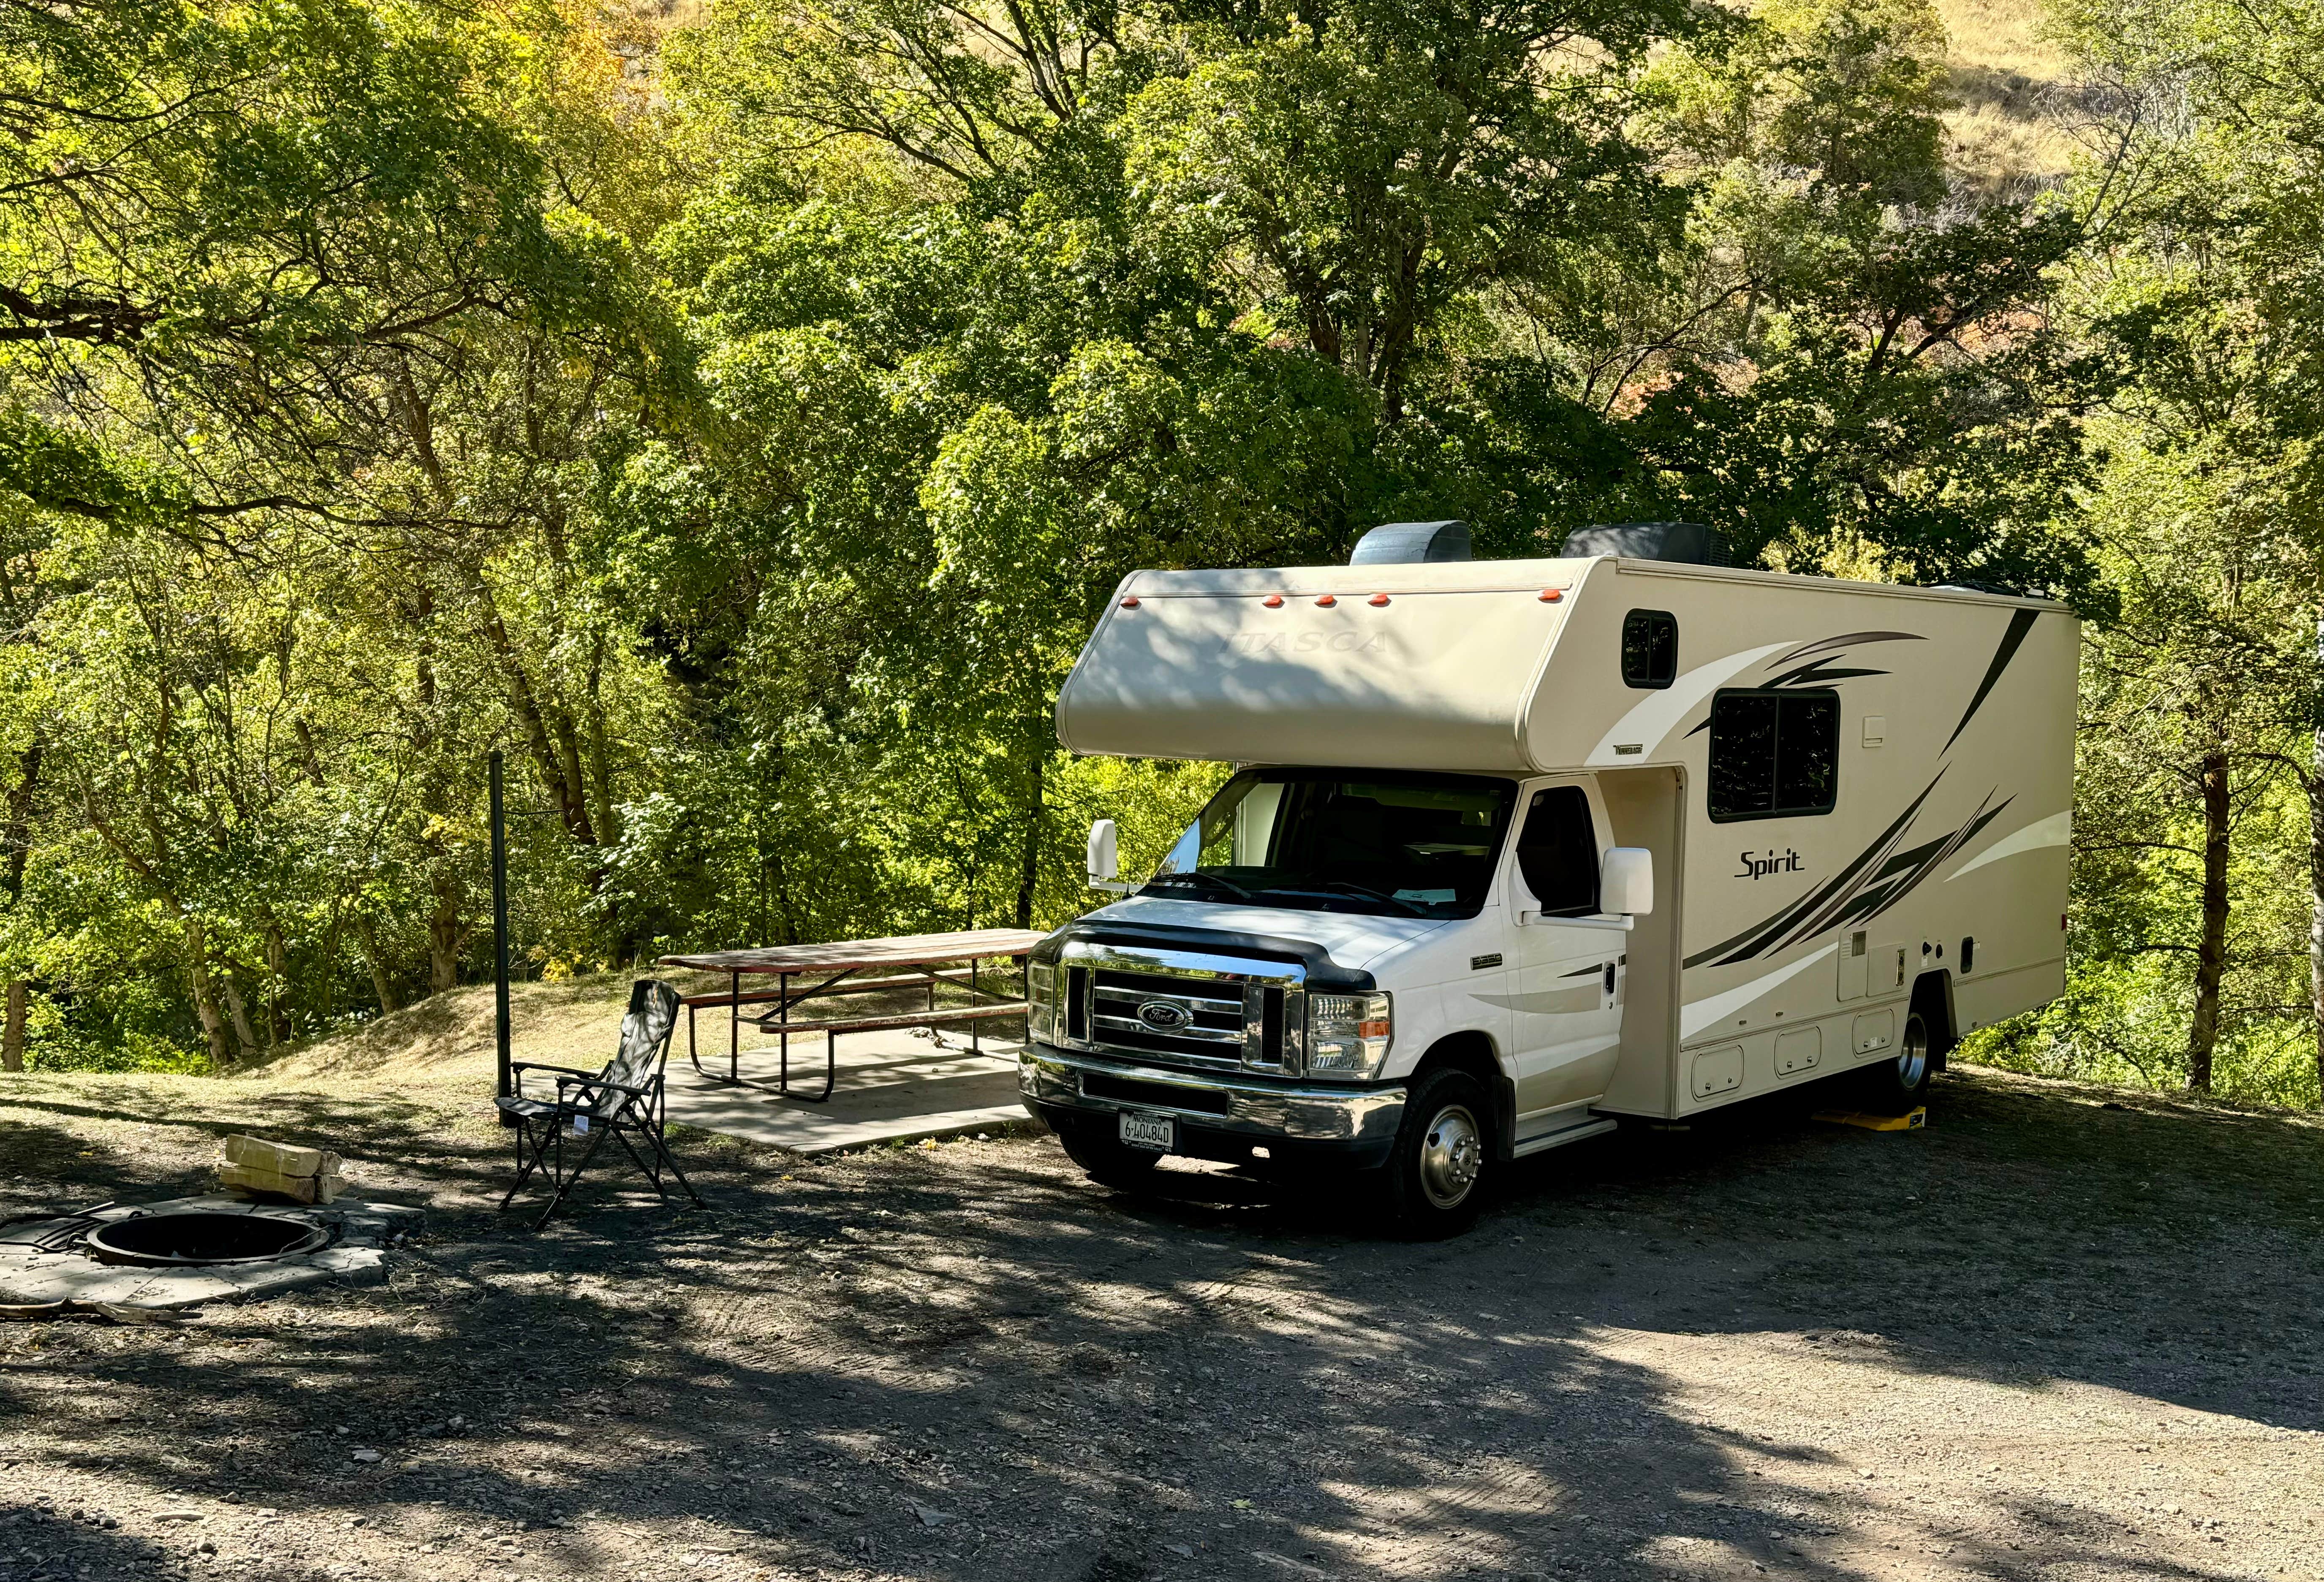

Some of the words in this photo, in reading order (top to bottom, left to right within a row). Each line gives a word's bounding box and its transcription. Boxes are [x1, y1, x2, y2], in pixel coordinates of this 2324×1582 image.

[1217, 631, 1387, 653] ITASCA
[1734, 848, 1805, 880] Spirit
[1149, 1008, 1173, 1022] Ford
[1133, 1115, 1162, 1126] MONTANA
